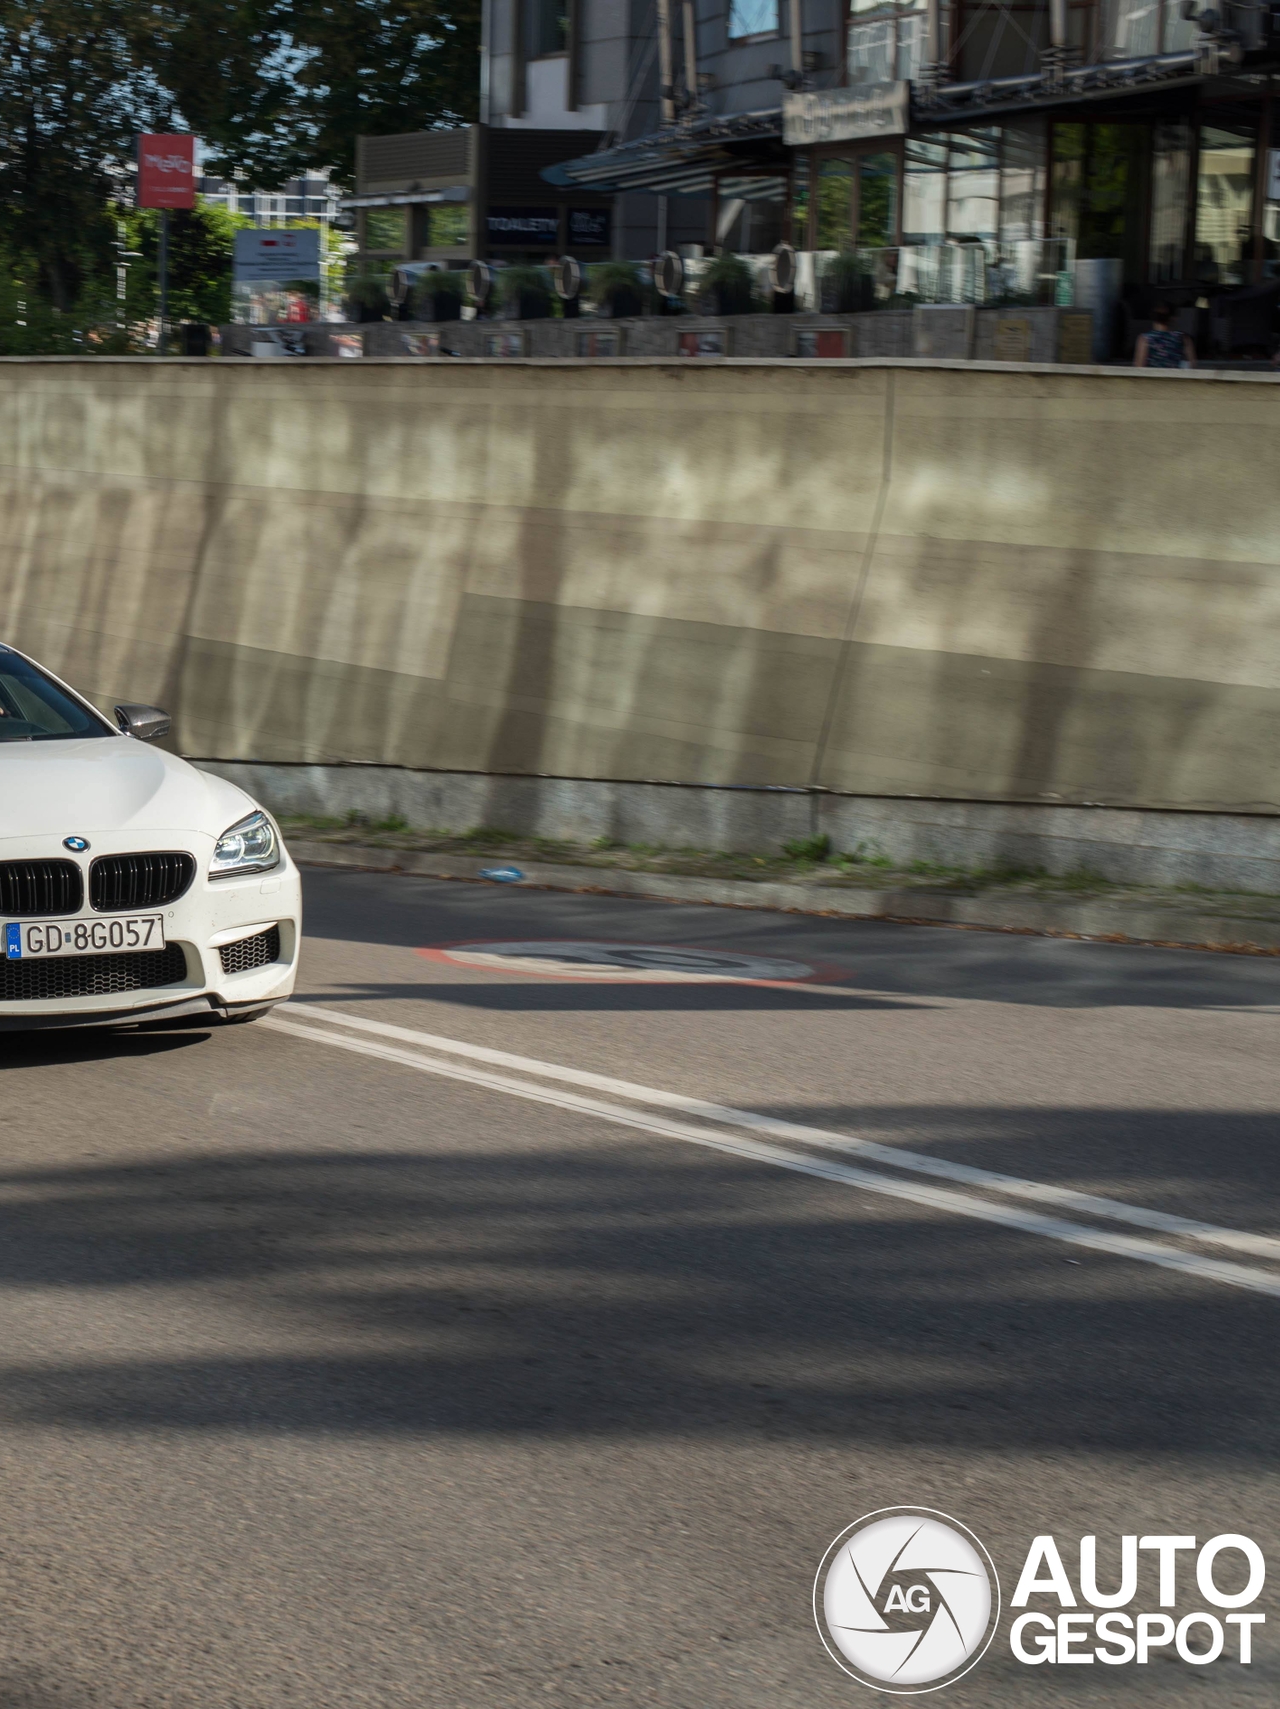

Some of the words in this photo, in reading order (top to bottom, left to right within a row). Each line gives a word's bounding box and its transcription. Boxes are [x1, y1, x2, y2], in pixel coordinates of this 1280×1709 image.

[26, 925, 63, 953] GD
[74, 918, 156, 951] 8G057
[9, 944, 19, 953] PL
